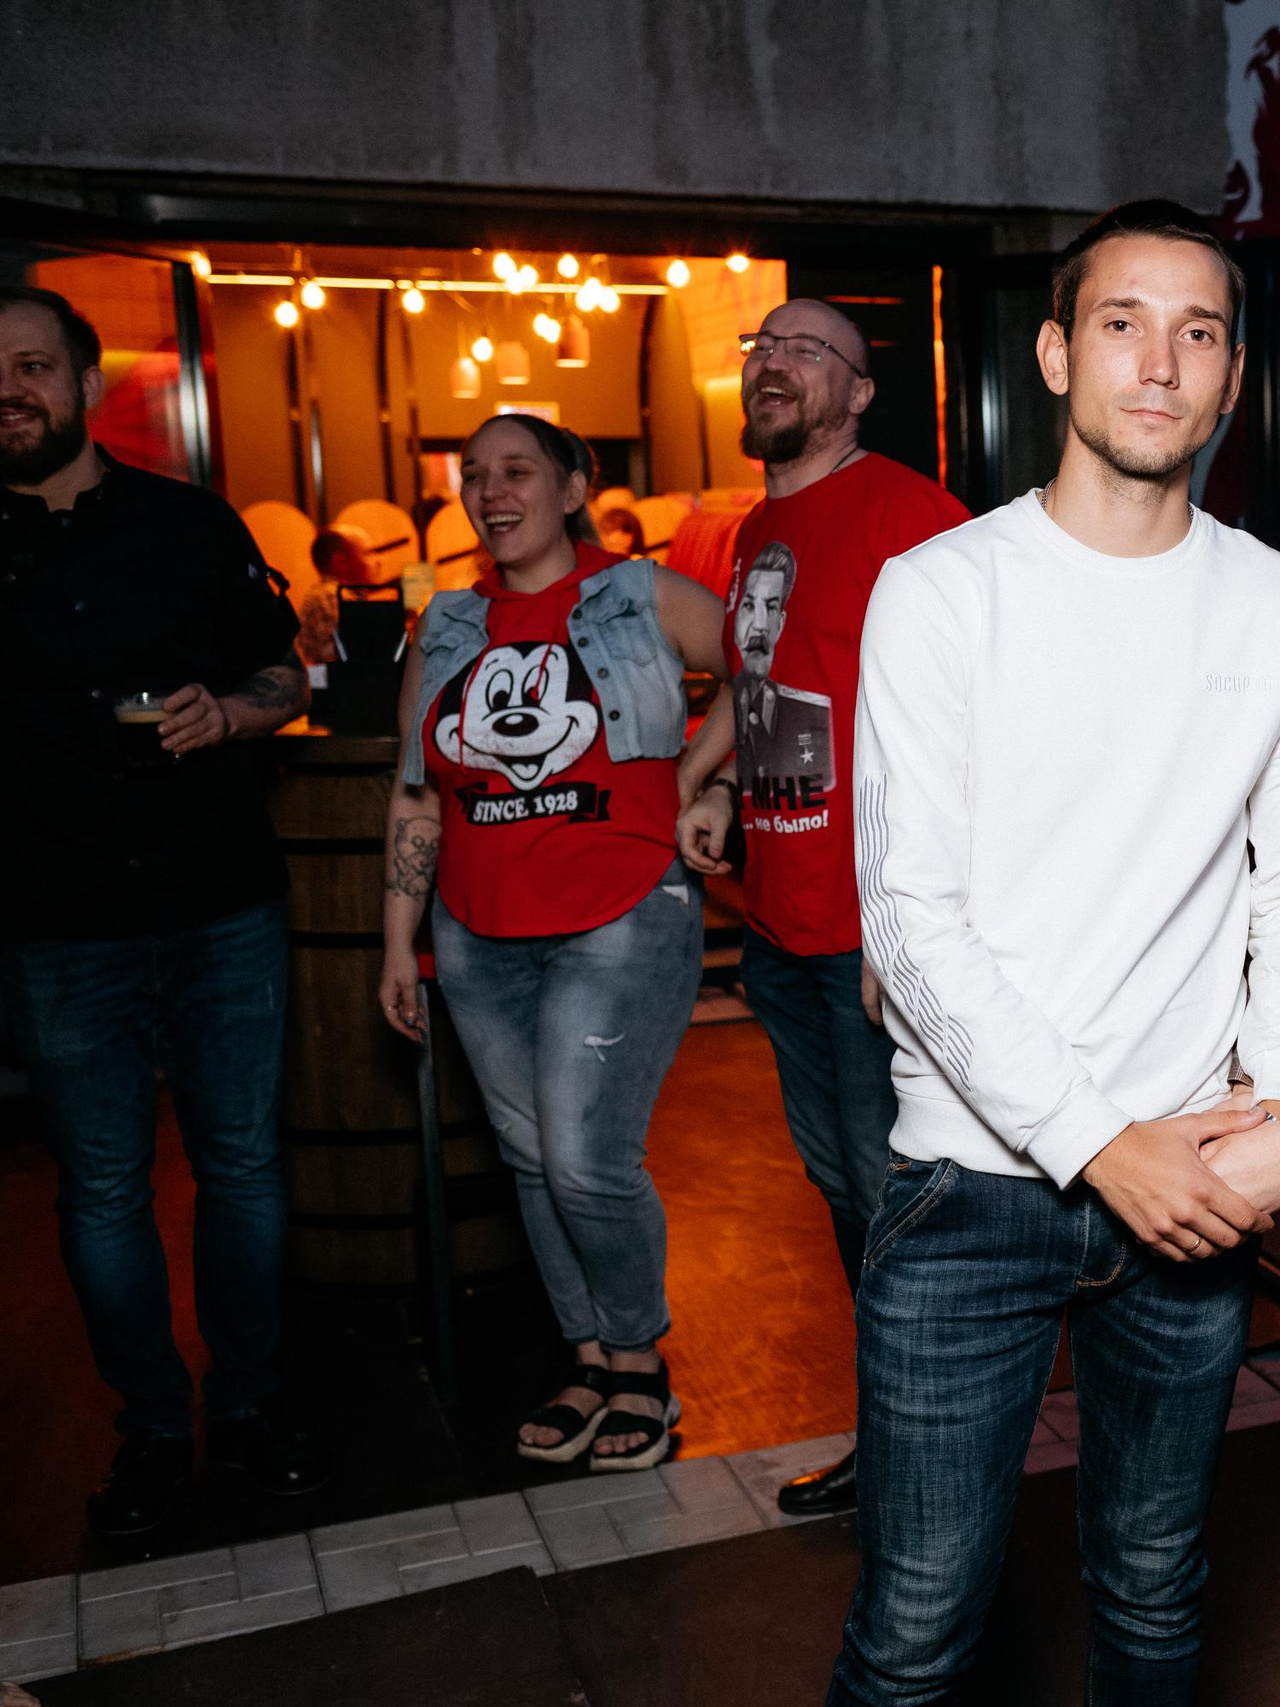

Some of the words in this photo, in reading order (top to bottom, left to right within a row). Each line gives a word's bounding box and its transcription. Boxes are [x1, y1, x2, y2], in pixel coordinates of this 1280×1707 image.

[473, 797, 530, 822] SINCE
[533, 789, 579, 816] 1928
[773, 809, 829, 834] было!
